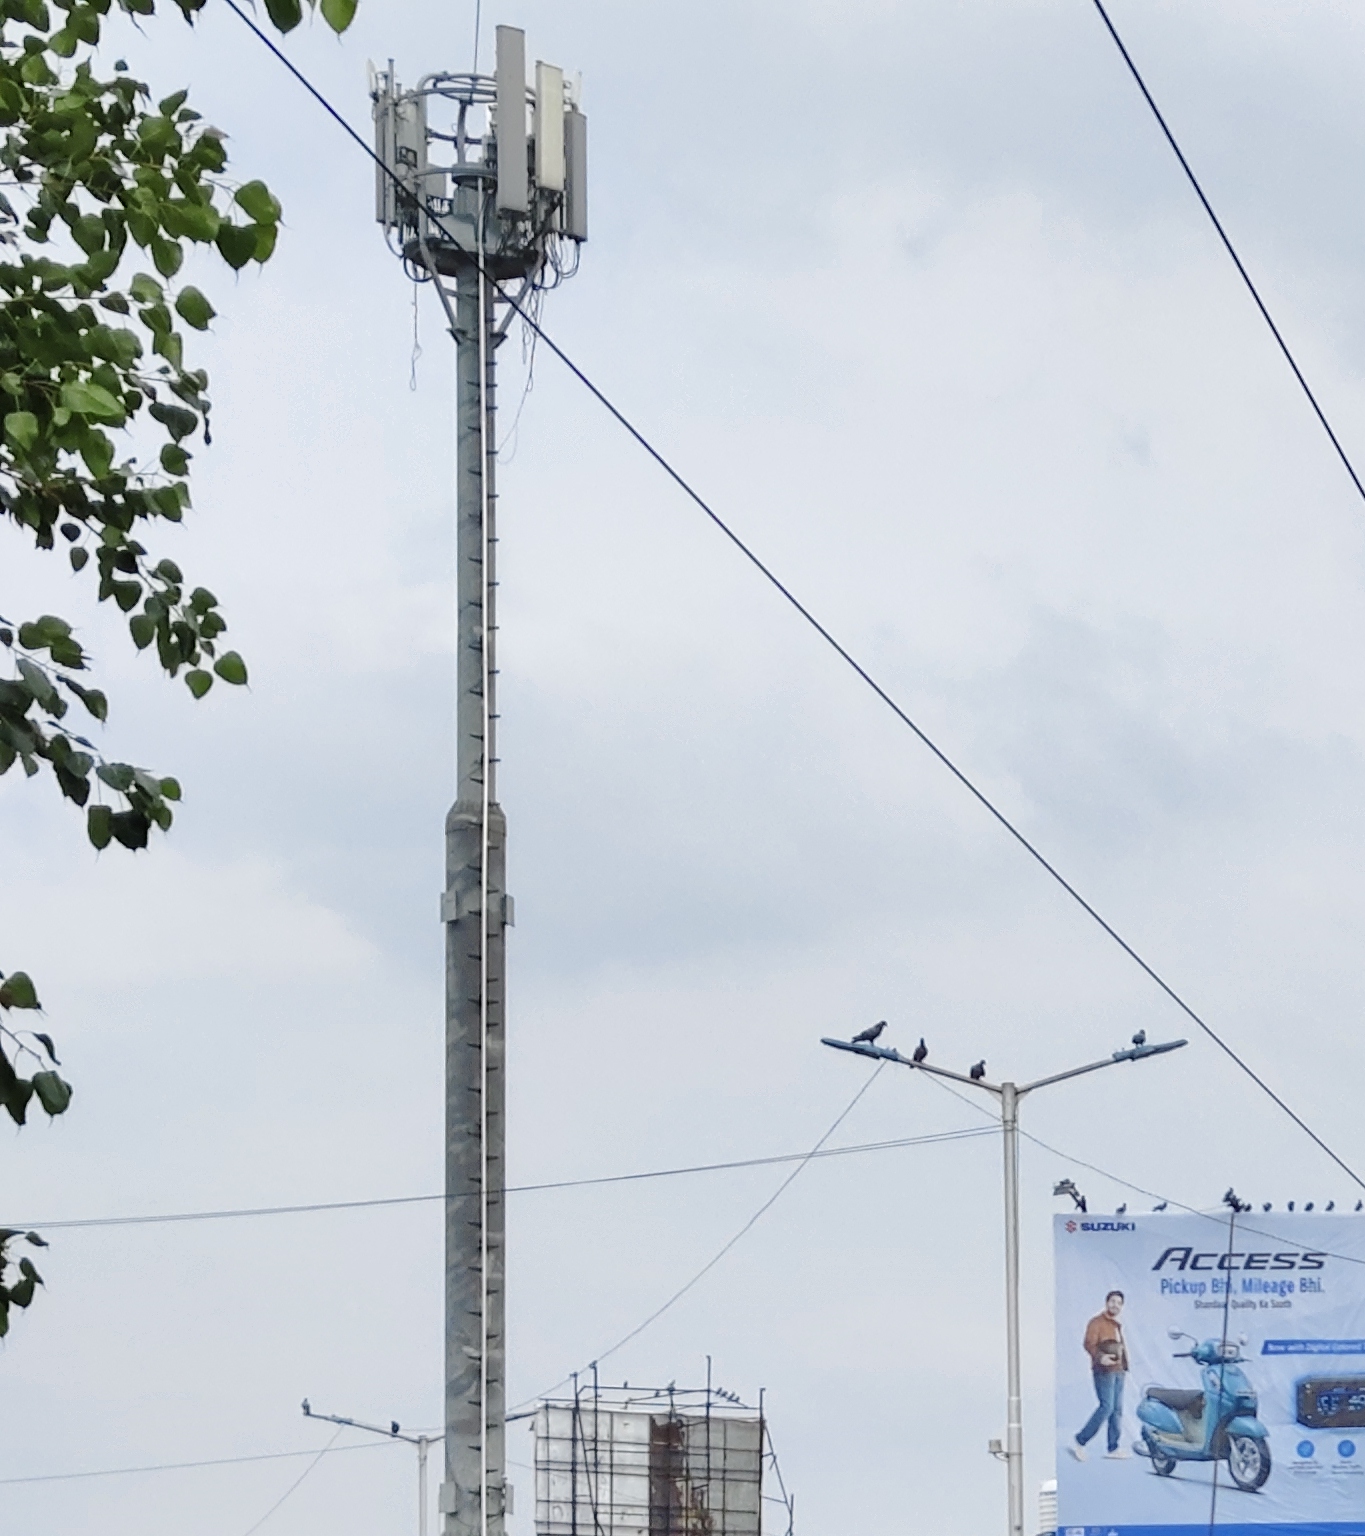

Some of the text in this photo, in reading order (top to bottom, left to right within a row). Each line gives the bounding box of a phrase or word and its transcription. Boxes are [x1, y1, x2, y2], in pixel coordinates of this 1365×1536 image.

[1081, 1221, 1136, 1232] SUZUKI
[1160, 1277, 1206, 1295] Pickup
[1241, 1277, 1295, 1297] Mileage
